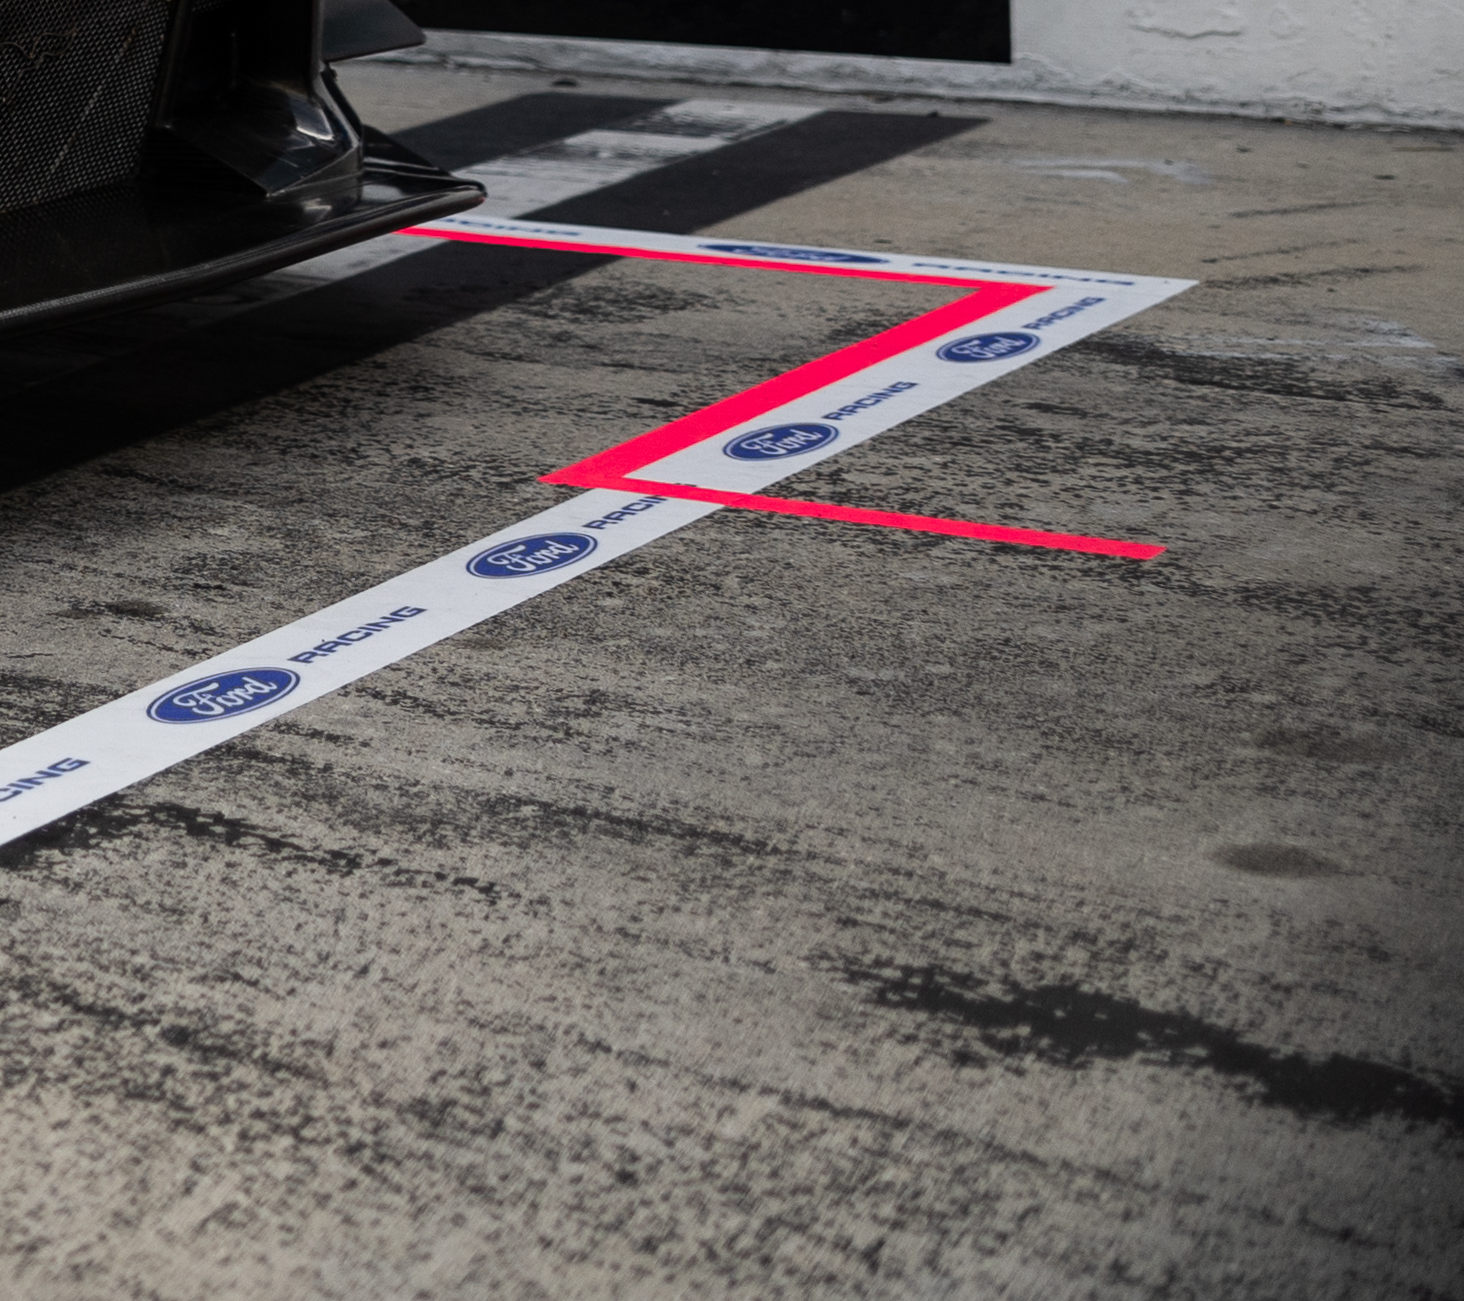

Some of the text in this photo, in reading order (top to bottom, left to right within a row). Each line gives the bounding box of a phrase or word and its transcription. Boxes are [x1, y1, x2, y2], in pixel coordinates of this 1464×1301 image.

[1024, 294, 1106, 332] RACING
[824, 380, 918, 422] RACING
[289, 604, 426, 665] RACING
